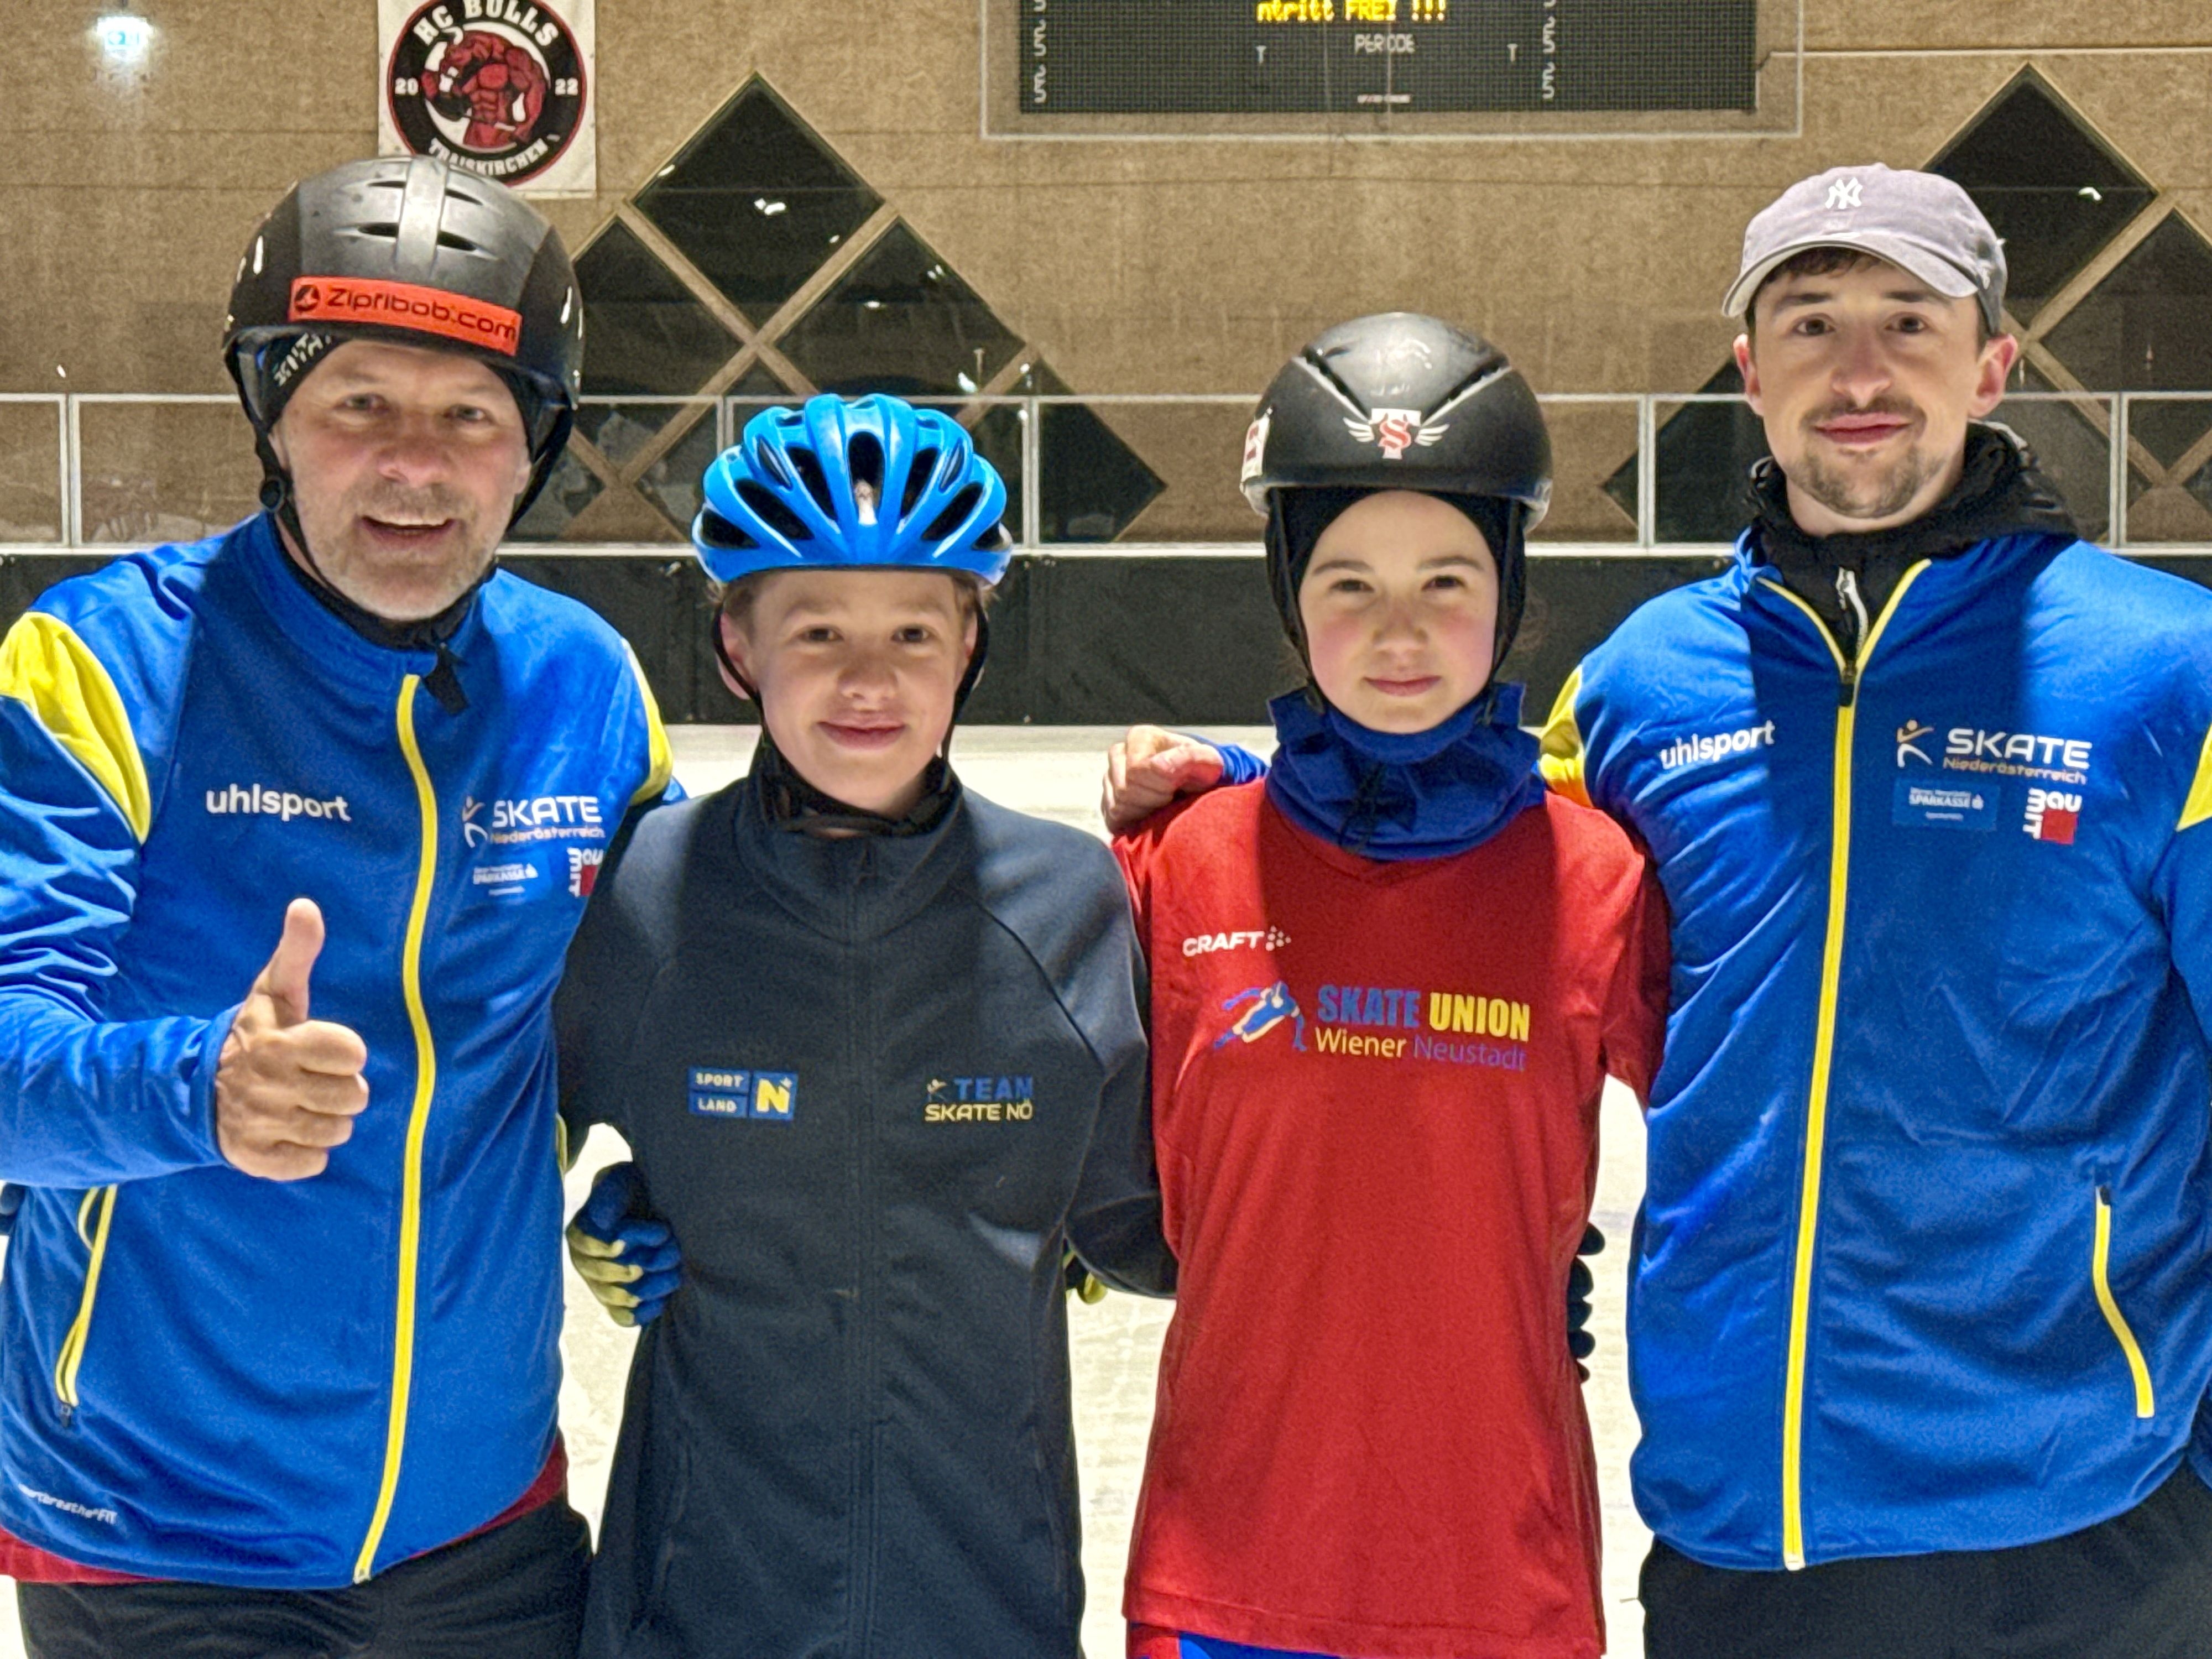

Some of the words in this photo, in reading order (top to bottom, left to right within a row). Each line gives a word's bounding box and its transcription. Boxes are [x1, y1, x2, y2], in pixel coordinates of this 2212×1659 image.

[413, 5, 453, 45] HC
[463, 0, 559, 46] BULLS
[394, 77, 419, 95] 20
[555, 77, 578, 96] 22
[1825, 178, 1863, 210] NY
[1660, 719, 1776, 769] uhlsport
[1945, 728, 2093, 769] SKATE
[206, 783, 352, 822] uhlsport
[492, 796, 603, 828] SKATE
[1183, 931, 1265, 957] CRAFT
[1318, 984, 1421, 1028] SKATE
[1430, 992, 1531, 1043] UNION
[1315, 1027, 1407, 1058] Wiener
[695, 1072, 745, 1087] SPORT
[953, 1076, 1033, 1101] TEAM
[698, 1097, 737, 1113] LAND
[925, 1104, 1002, 1121] SKATE
